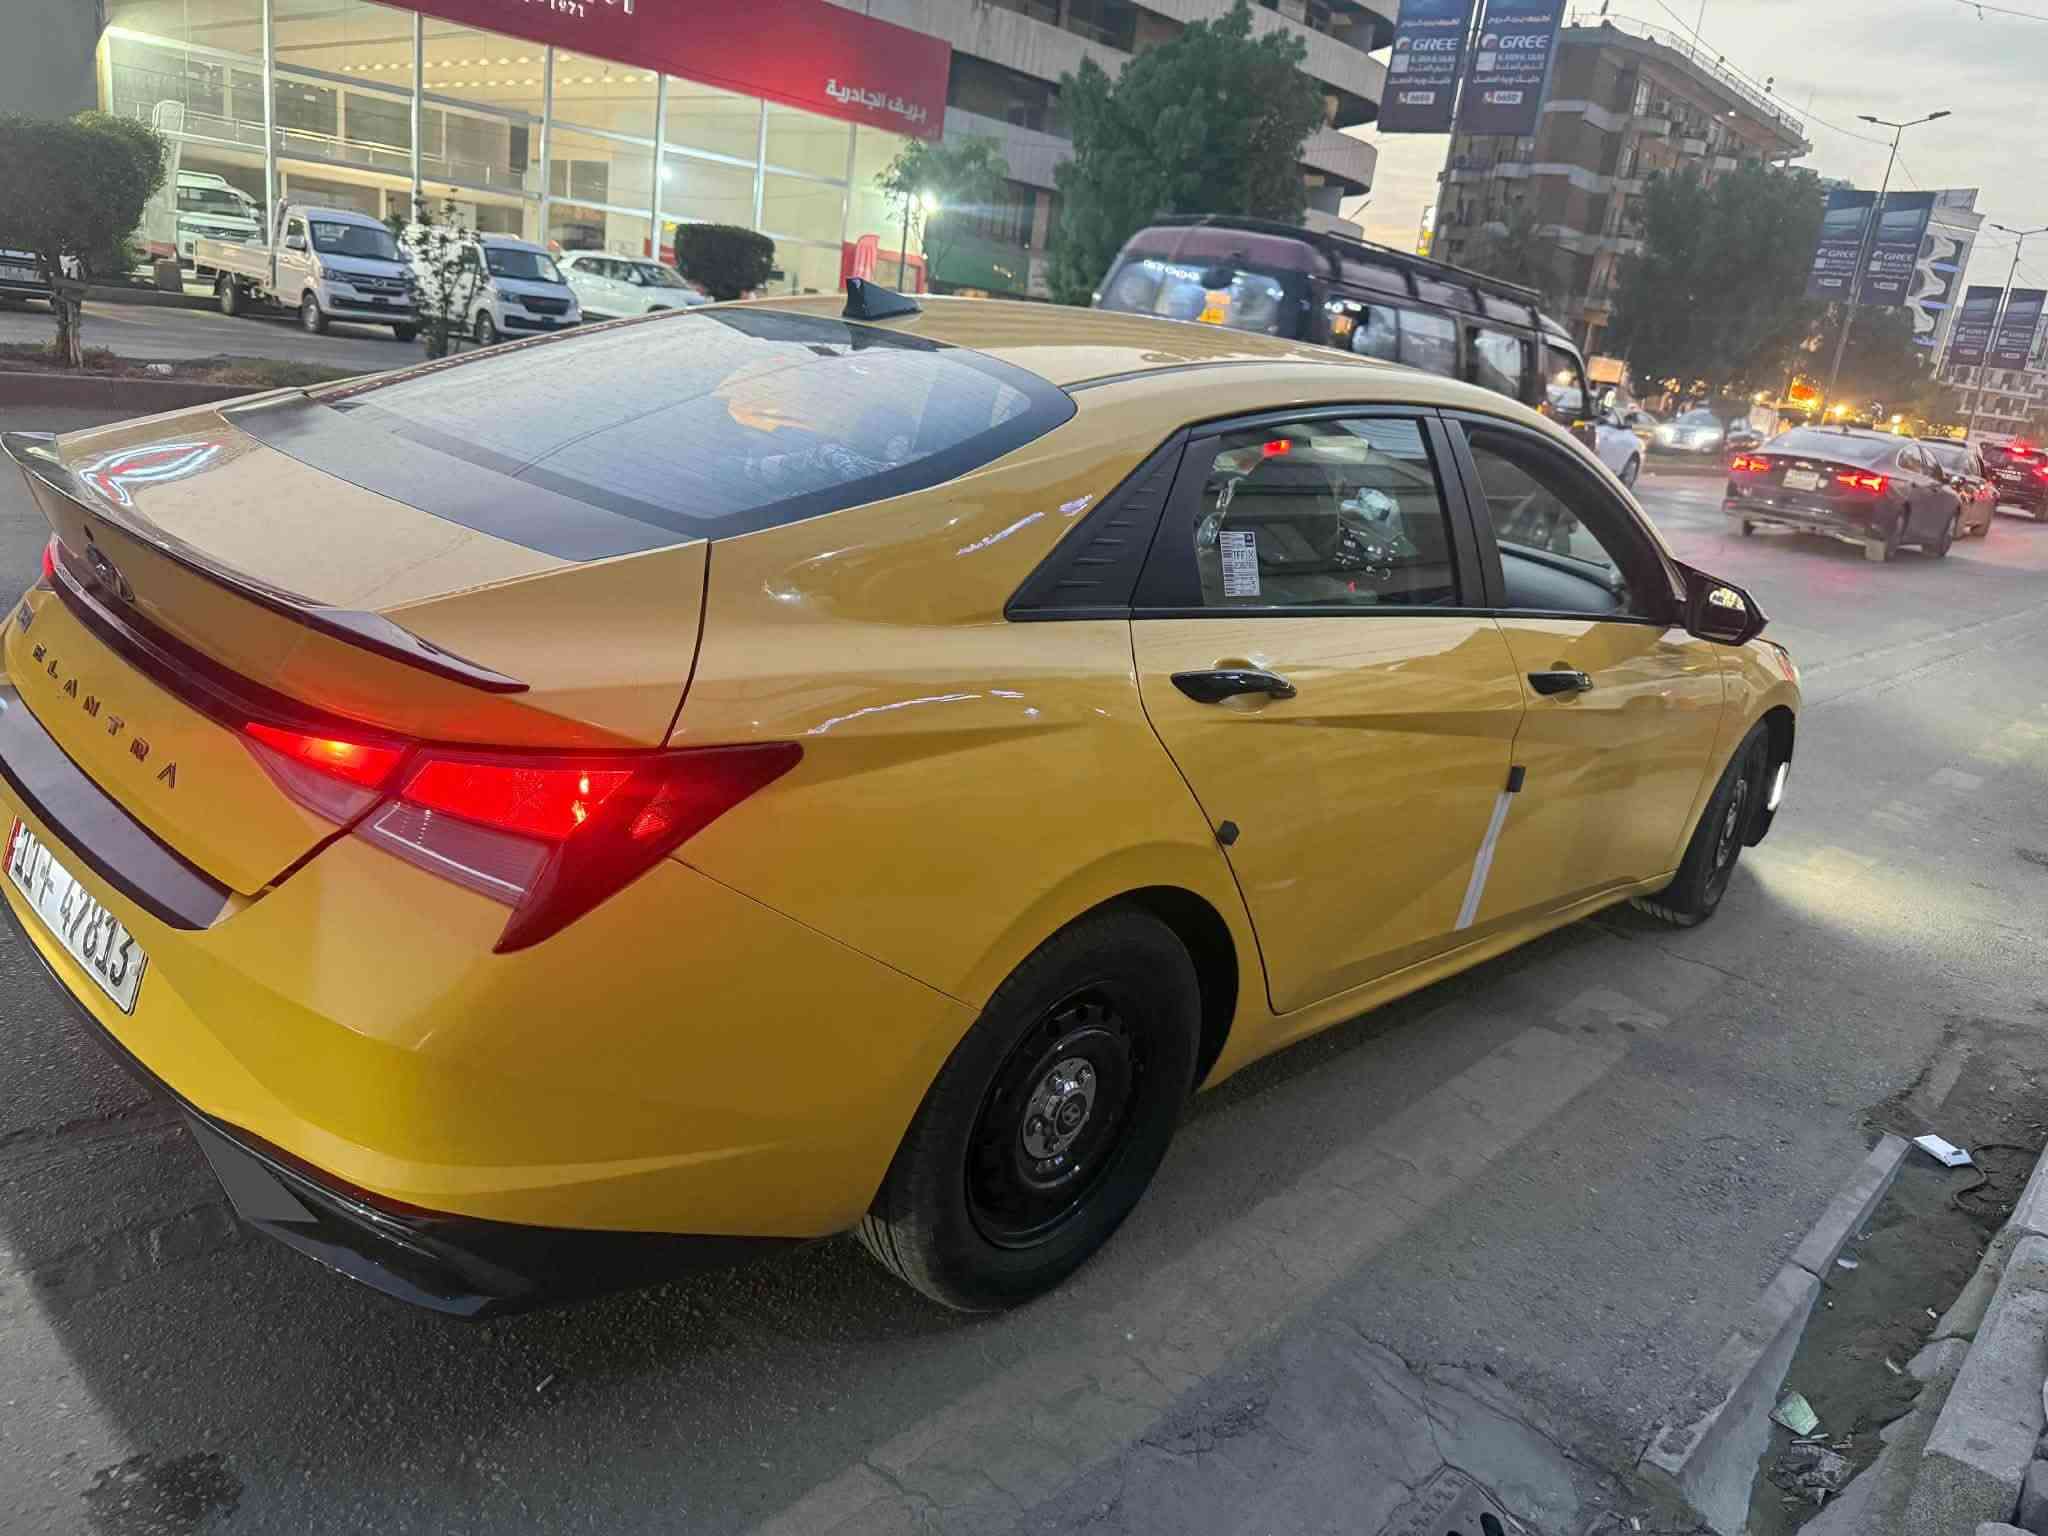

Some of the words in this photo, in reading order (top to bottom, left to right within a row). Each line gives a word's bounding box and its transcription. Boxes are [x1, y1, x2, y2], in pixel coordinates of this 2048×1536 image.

[1412, 38, 1459, 51] GREE
[1499, 34, 1551, 49] GREE
[32, 643, 177, 789] ELANTRA
[59, 878, 135, 987] 47813
